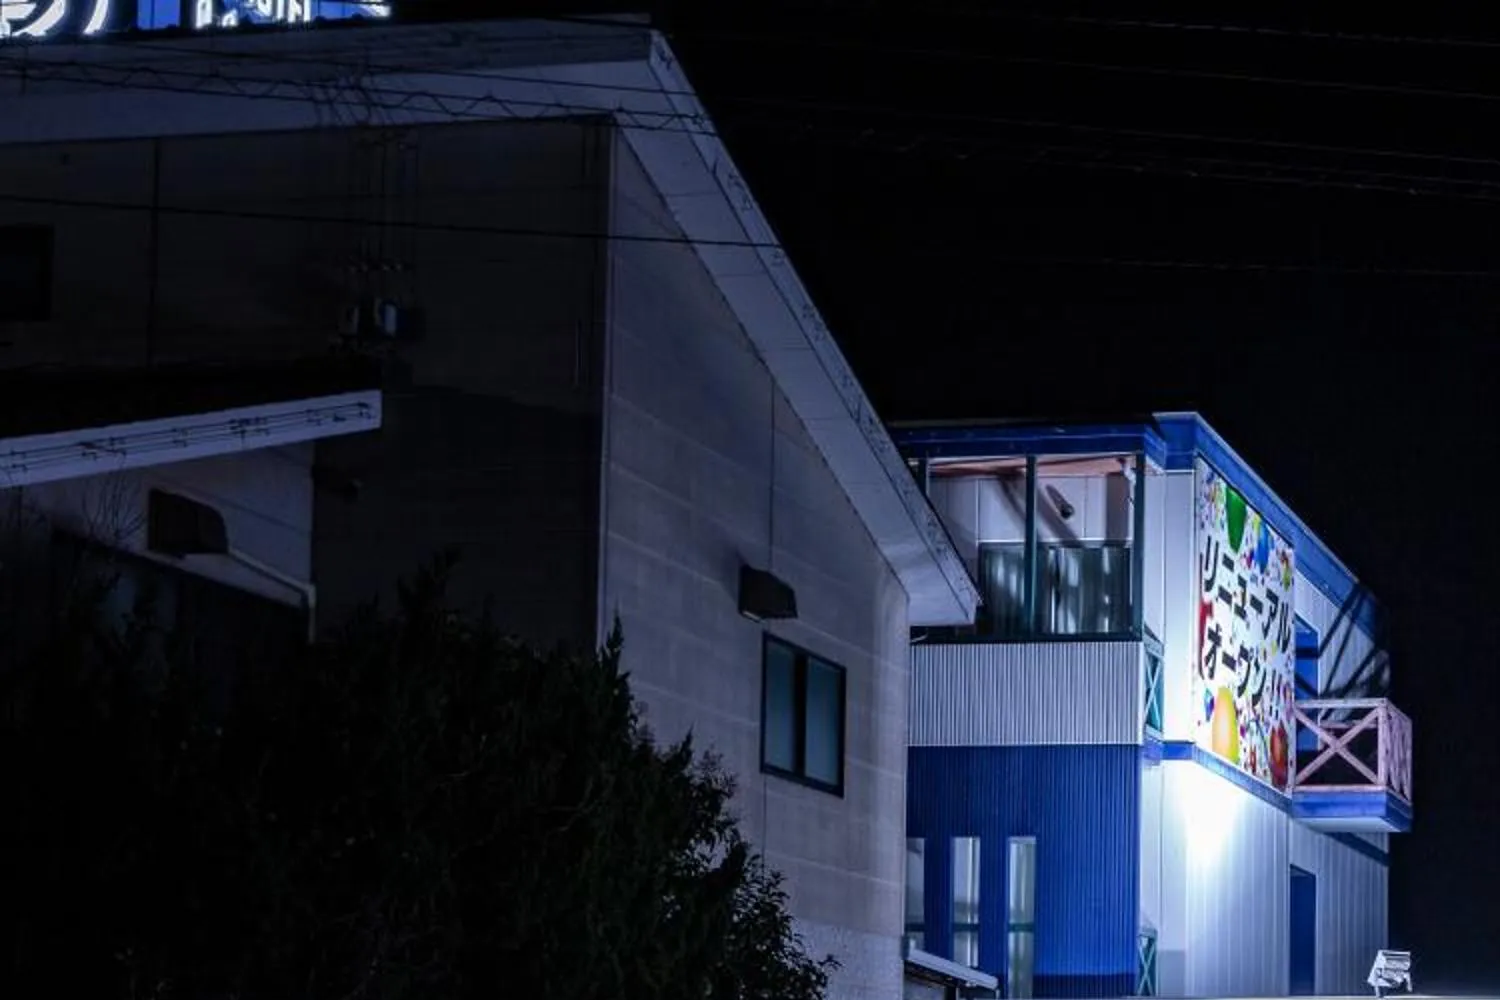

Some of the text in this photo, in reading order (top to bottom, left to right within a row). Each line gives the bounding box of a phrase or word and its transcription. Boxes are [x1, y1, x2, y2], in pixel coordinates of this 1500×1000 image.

[1204, 535, 1291, 652] リニューアル
